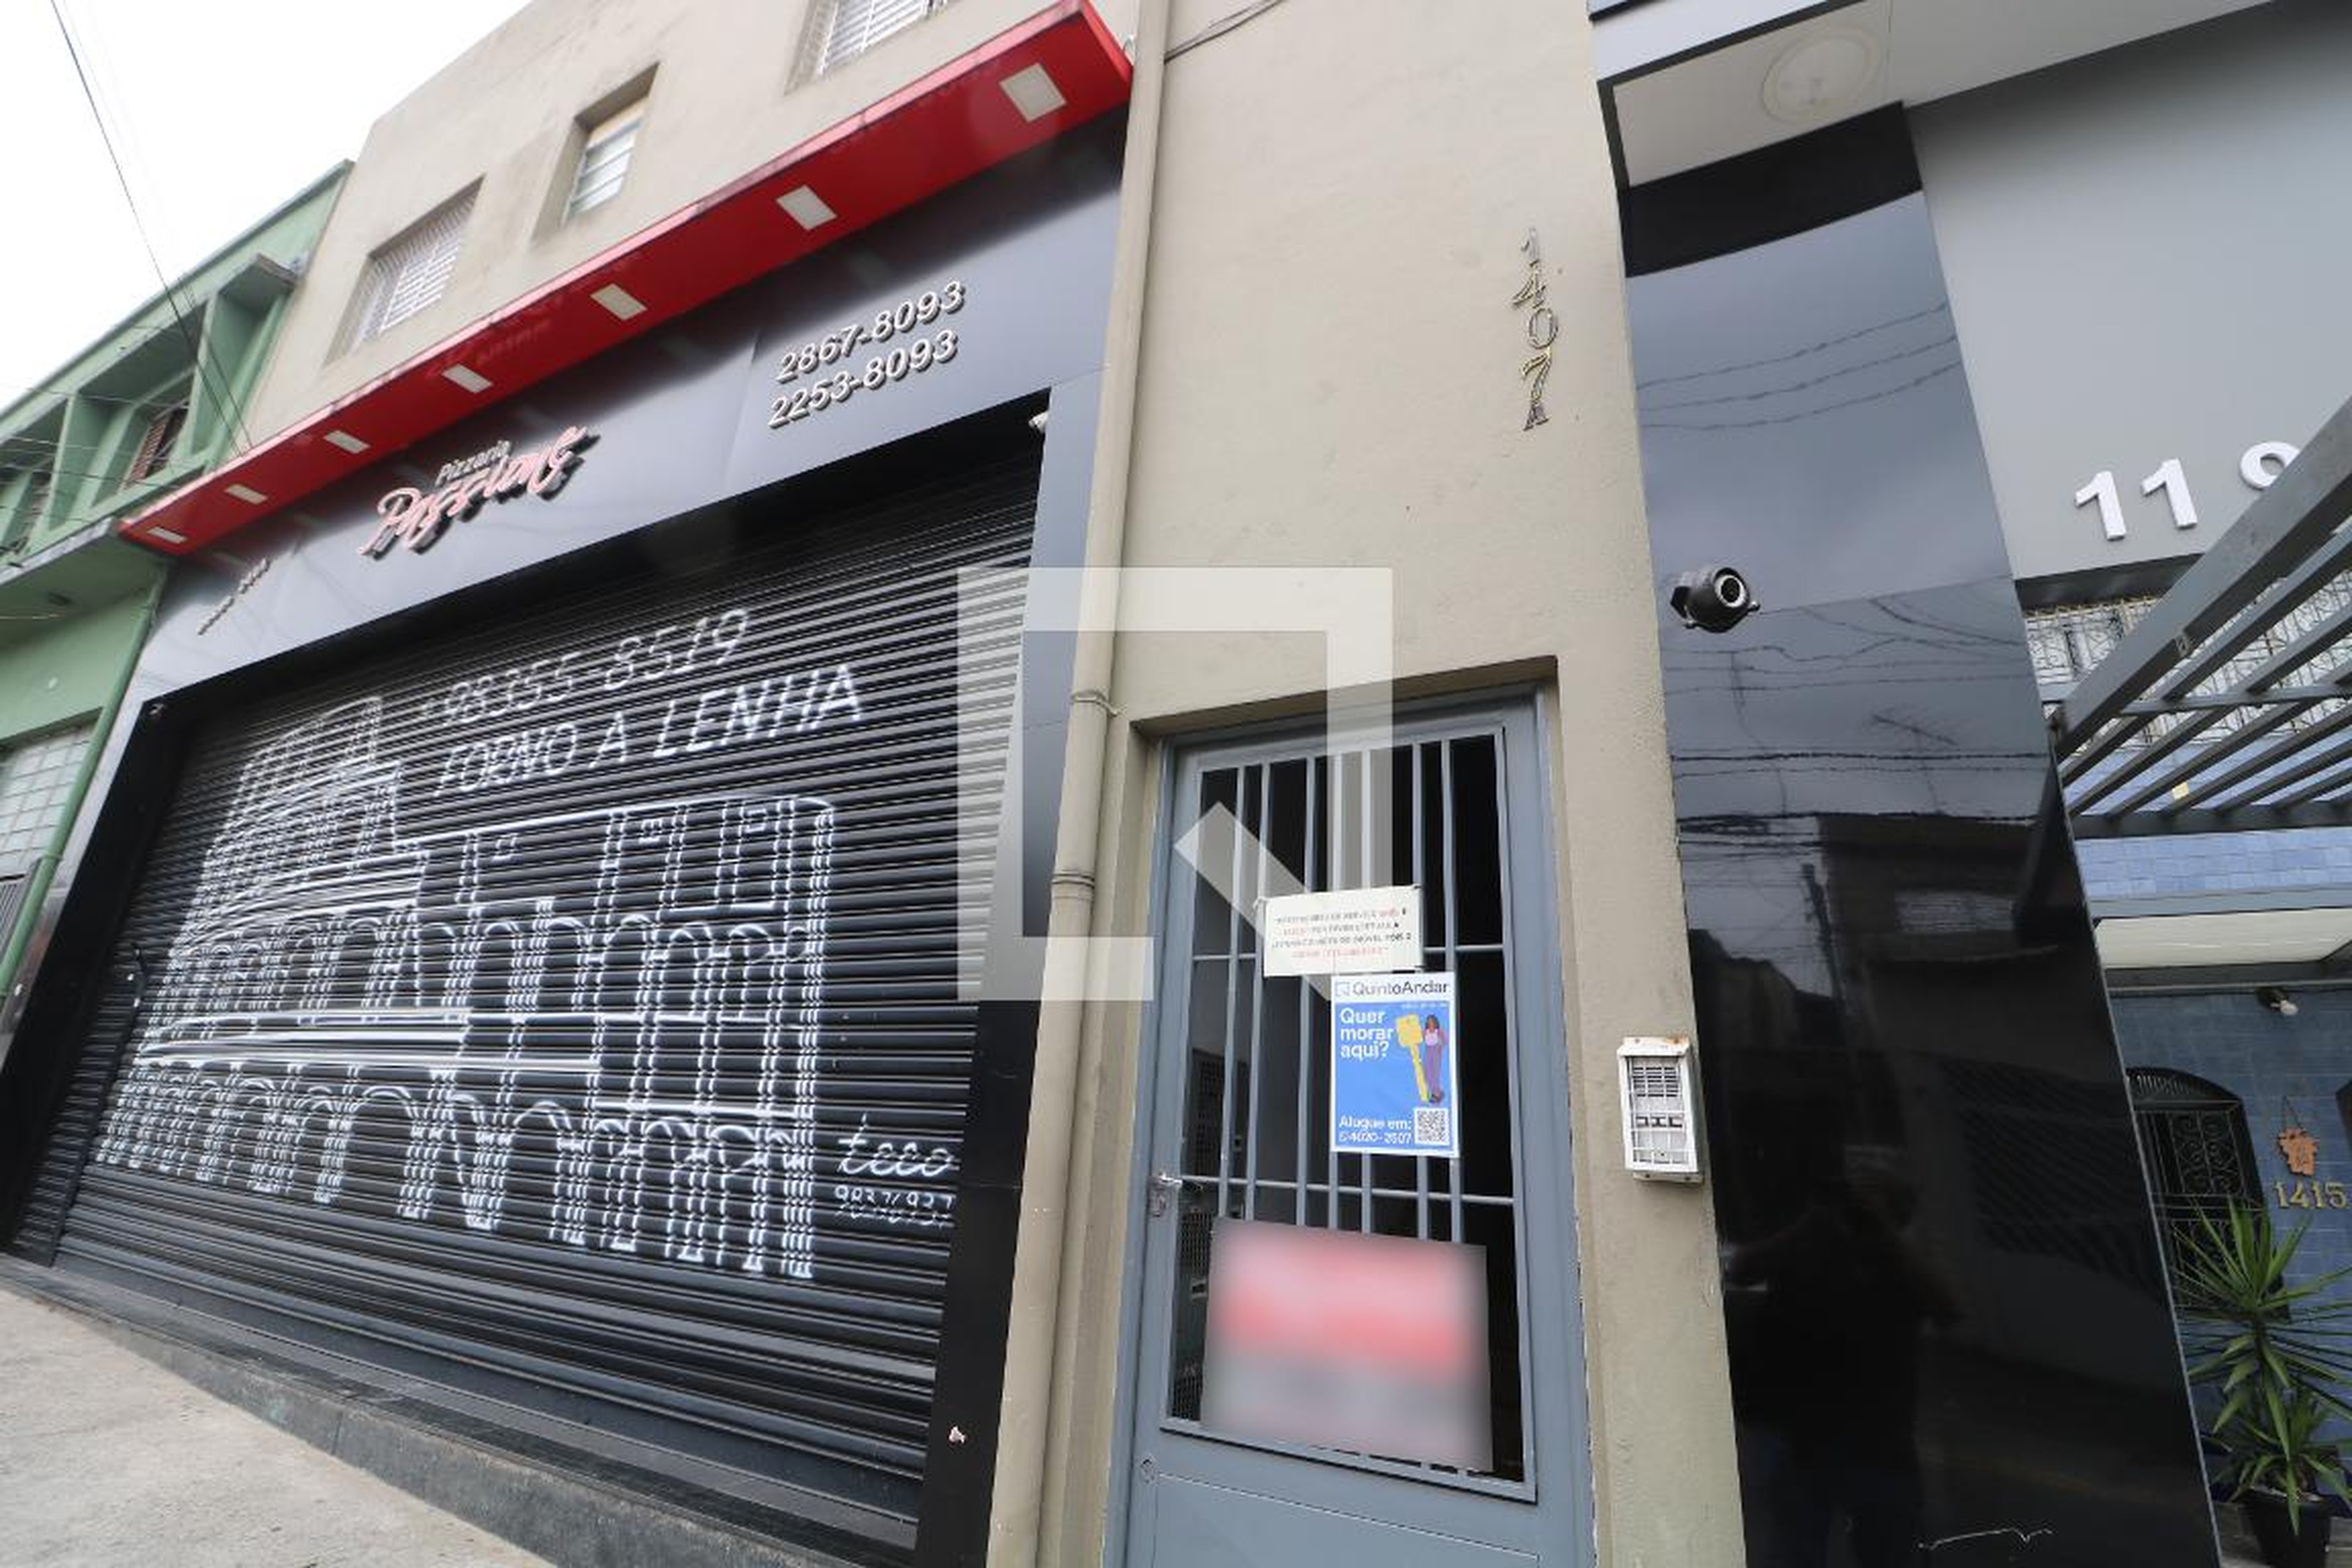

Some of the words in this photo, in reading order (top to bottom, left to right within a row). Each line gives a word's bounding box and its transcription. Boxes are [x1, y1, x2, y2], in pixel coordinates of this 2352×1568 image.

[775, 281, 965, 383] 2867-8093
[767, 329, 959, 428] 2253-8093
[435, 723, 578, 797] FORNO
[589, 711, 627, 768] A
[652, 664, 863, 758] LENHA
[1353, 981, 1449, 997] QuintoAndar
[1340, 1008, 1385, 1023] Quer
[1340, 1027, 1393, 1041] morar
[1340, 1041, 1389, 1060] aqui?
[2273, 1178, 2348, 1210] 1415
